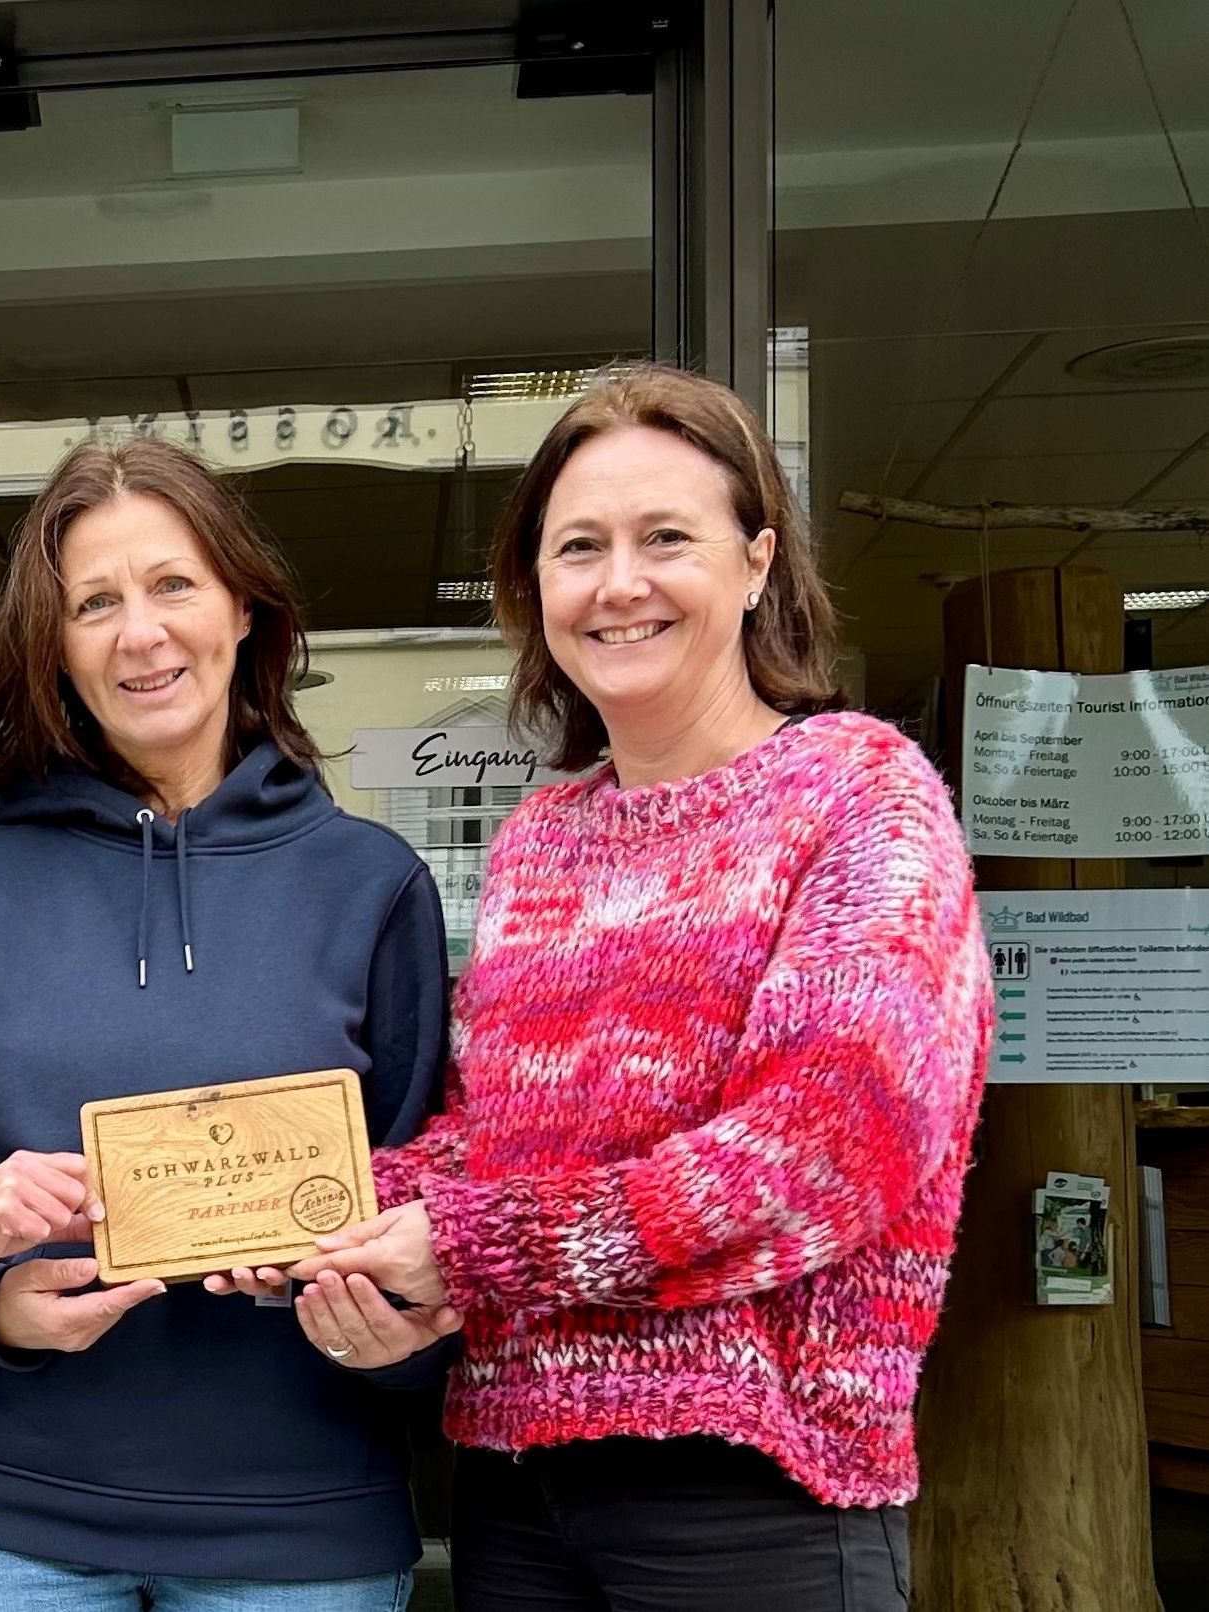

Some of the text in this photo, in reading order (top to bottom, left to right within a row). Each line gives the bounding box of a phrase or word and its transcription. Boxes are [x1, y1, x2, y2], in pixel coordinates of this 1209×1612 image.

[976, 692, 1072, 713] Öffnungszeiten
[1077, 700, 1125, 713] Tourist
[974, 730, 998, 742] April
[1020, 733, 1083, 746] September
[411, 732, 537, 783] Eingang
[974, 746, 1016, 761] Montag
[1030, 750, 1069, 764] Freitag
[1121, 749, 1151, 761] 9:00
[1161, 746, 1199, 759] 17:00
[994, 763, 1009, 774] So
[1012, 765, 1021, 775] &
[1024, 766, 1078, 779] Feiertage
[1113, 765, 1151, 777] 10:00
[973, 794, 1070, 809] Oktober bis März
[973, 813, 1016, 828] Montag
[1030, 816, 1070, 830] Freitag
[1122, 816, 1152, 827] 9:00
[1163, 813, 1201, 826] 17:00
[994, 829, 1009, 840] So
[1012, 830, 1021, 840] &
[1025, 831, 1079, 845] Feiertage
[1115, 831, 1152, 842] 10:00
[1163, 828, 1201, 841] 12:00
[1026, 911, 1089, 923] Bad Wildbad
[133, 1145, 320, 1181] SCHWARZWALD
[203, 1172, 254, 1188] PLUS
[188, 1198, 281, 1220] PARTNER
